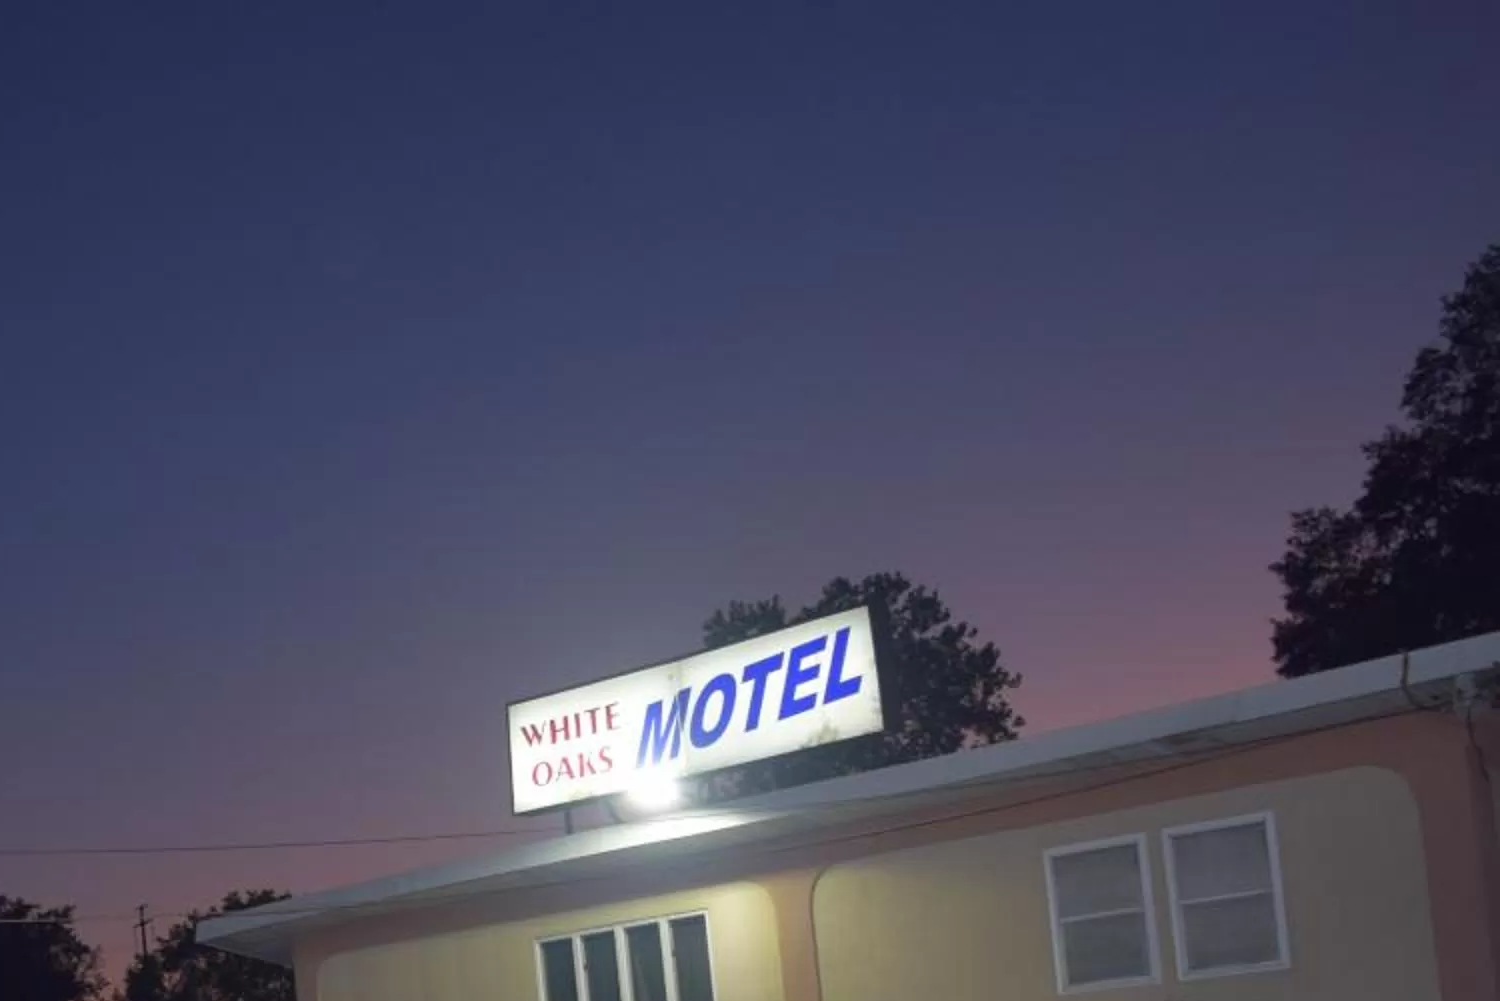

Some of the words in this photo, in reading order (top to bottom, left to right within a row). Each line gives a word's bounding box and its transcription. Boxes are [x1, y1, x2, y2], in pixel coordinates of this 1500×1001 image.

[635, 626, 863, 769] MOTEL
[520, 701, 622, 748] WHITE
[531, 746, 614, 787] OAKS
